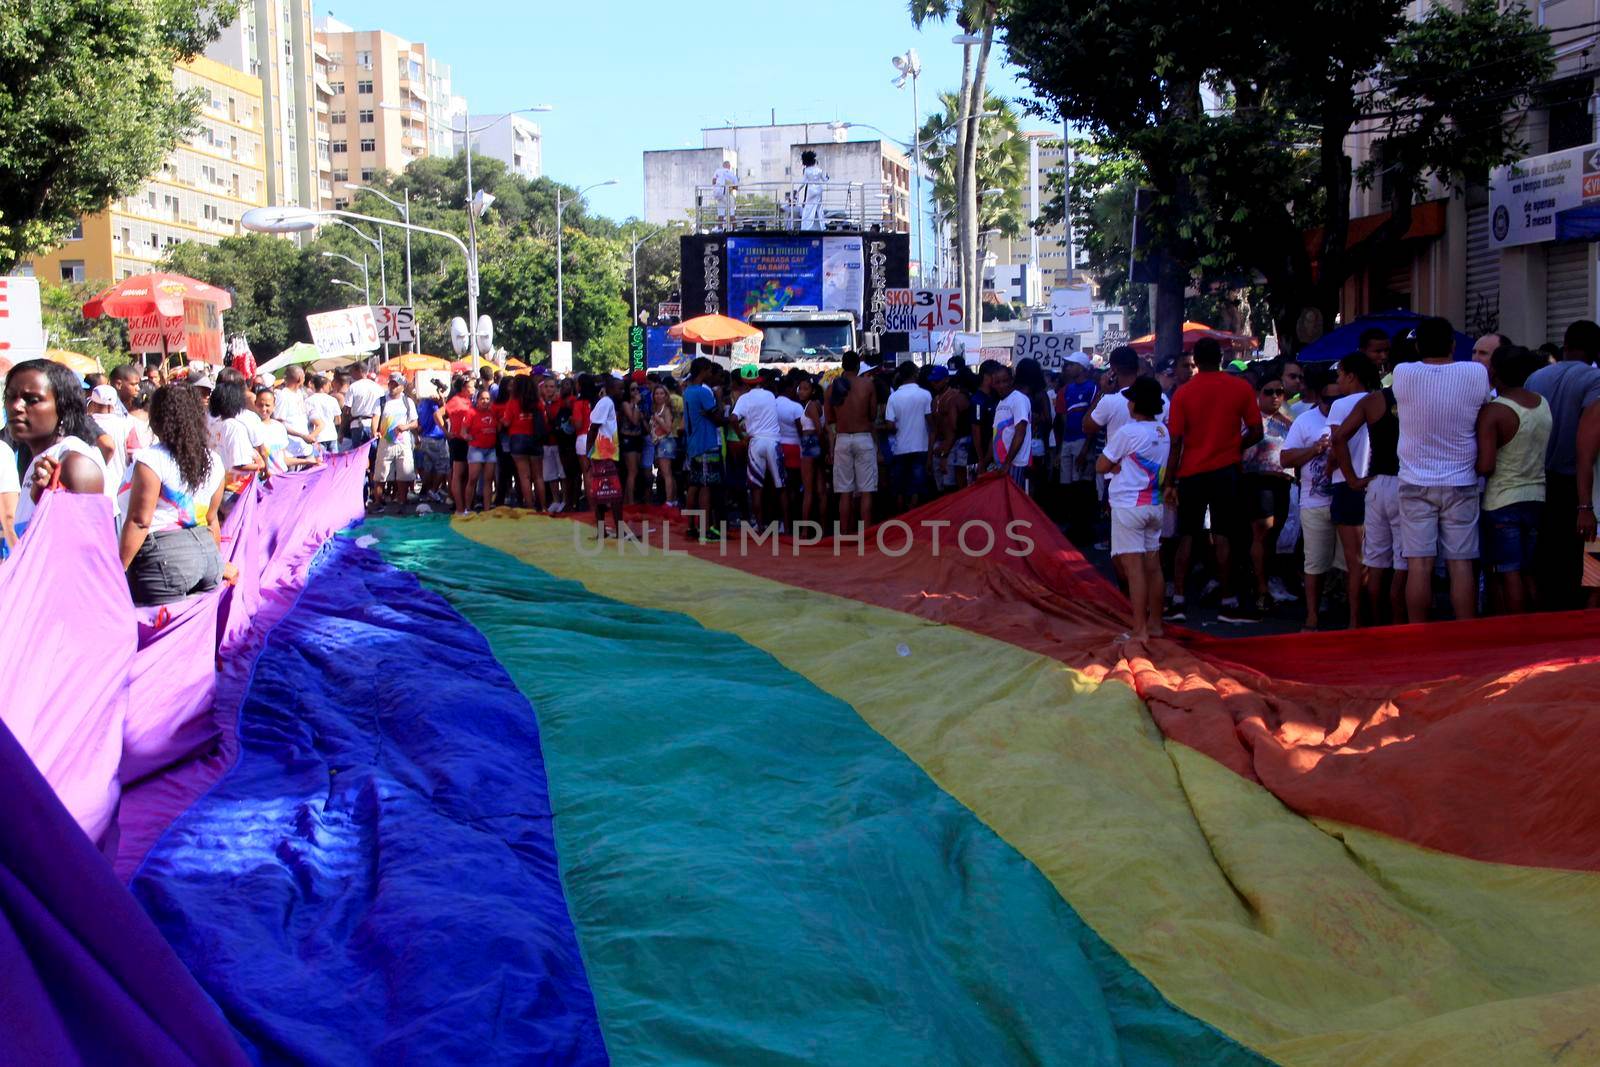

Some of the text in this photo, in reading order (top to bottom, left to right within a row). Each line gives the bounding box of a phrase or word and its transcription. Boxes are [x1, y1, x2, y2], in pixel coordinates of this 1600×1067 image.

[1533, 198, 1556, 213] apenas
[1532, 215, 1552, 227] meses
[761, 256, 790, 264] PARADA
[791, 256, 806, 264] GAY
[377, 307, 391, 323] 3
[397, 307, 414, 323] 5
[886, 291, 917, 305] SKOL
[916, 292, 934, 306] 3
[948, 293, 963, 325] 5
[363, 313, 376, 343] 5
[886, 312, 935, 331] SCHIN 4
[377, 325, 391, 342] 4
[1029, 335, 1074, 353] POR
